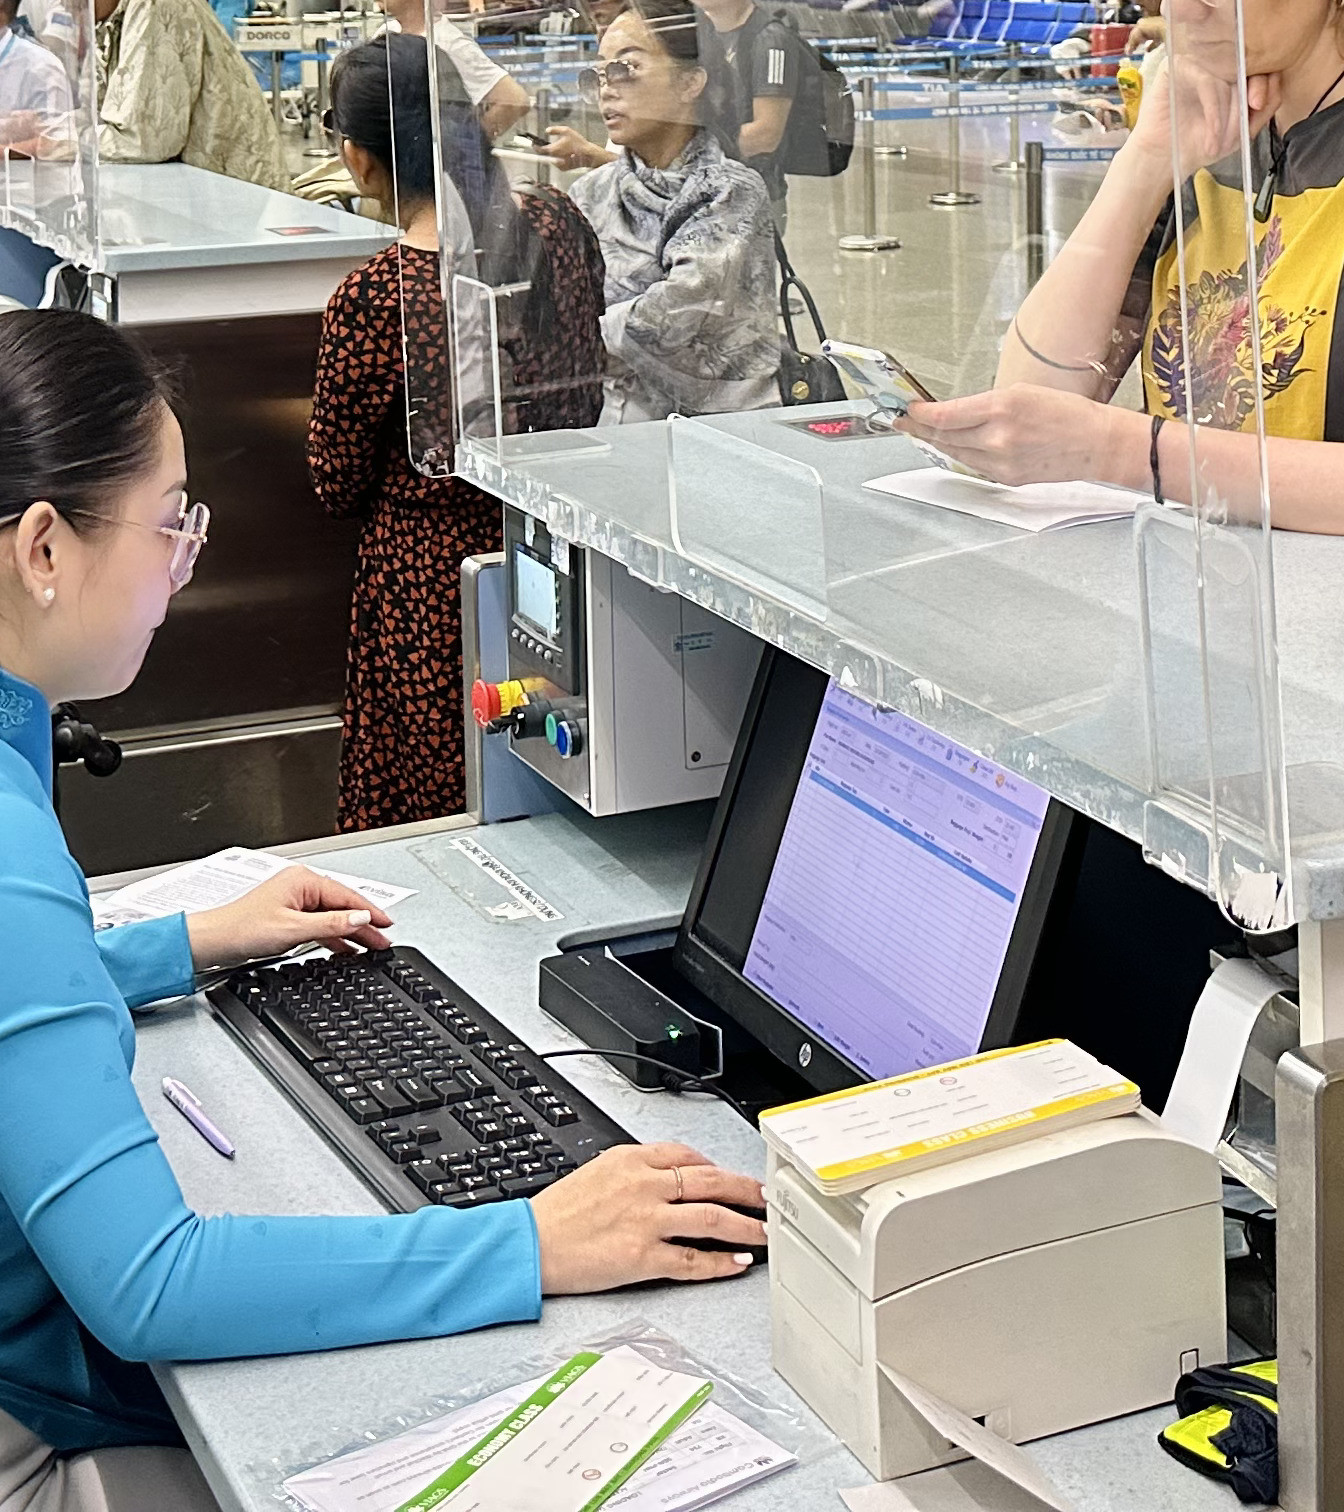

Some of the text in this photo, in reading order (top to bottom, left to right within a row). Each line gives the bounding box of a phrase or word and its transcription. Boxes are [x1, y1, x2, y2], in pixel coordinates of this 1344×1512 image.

[246, 31, 291, 40] DORCO
[466, 1427, 517, 1468] ECONOMY
[508, 1402, 544, 1432] CLASS
[699, 1460, 755, 1488] Cambodia
